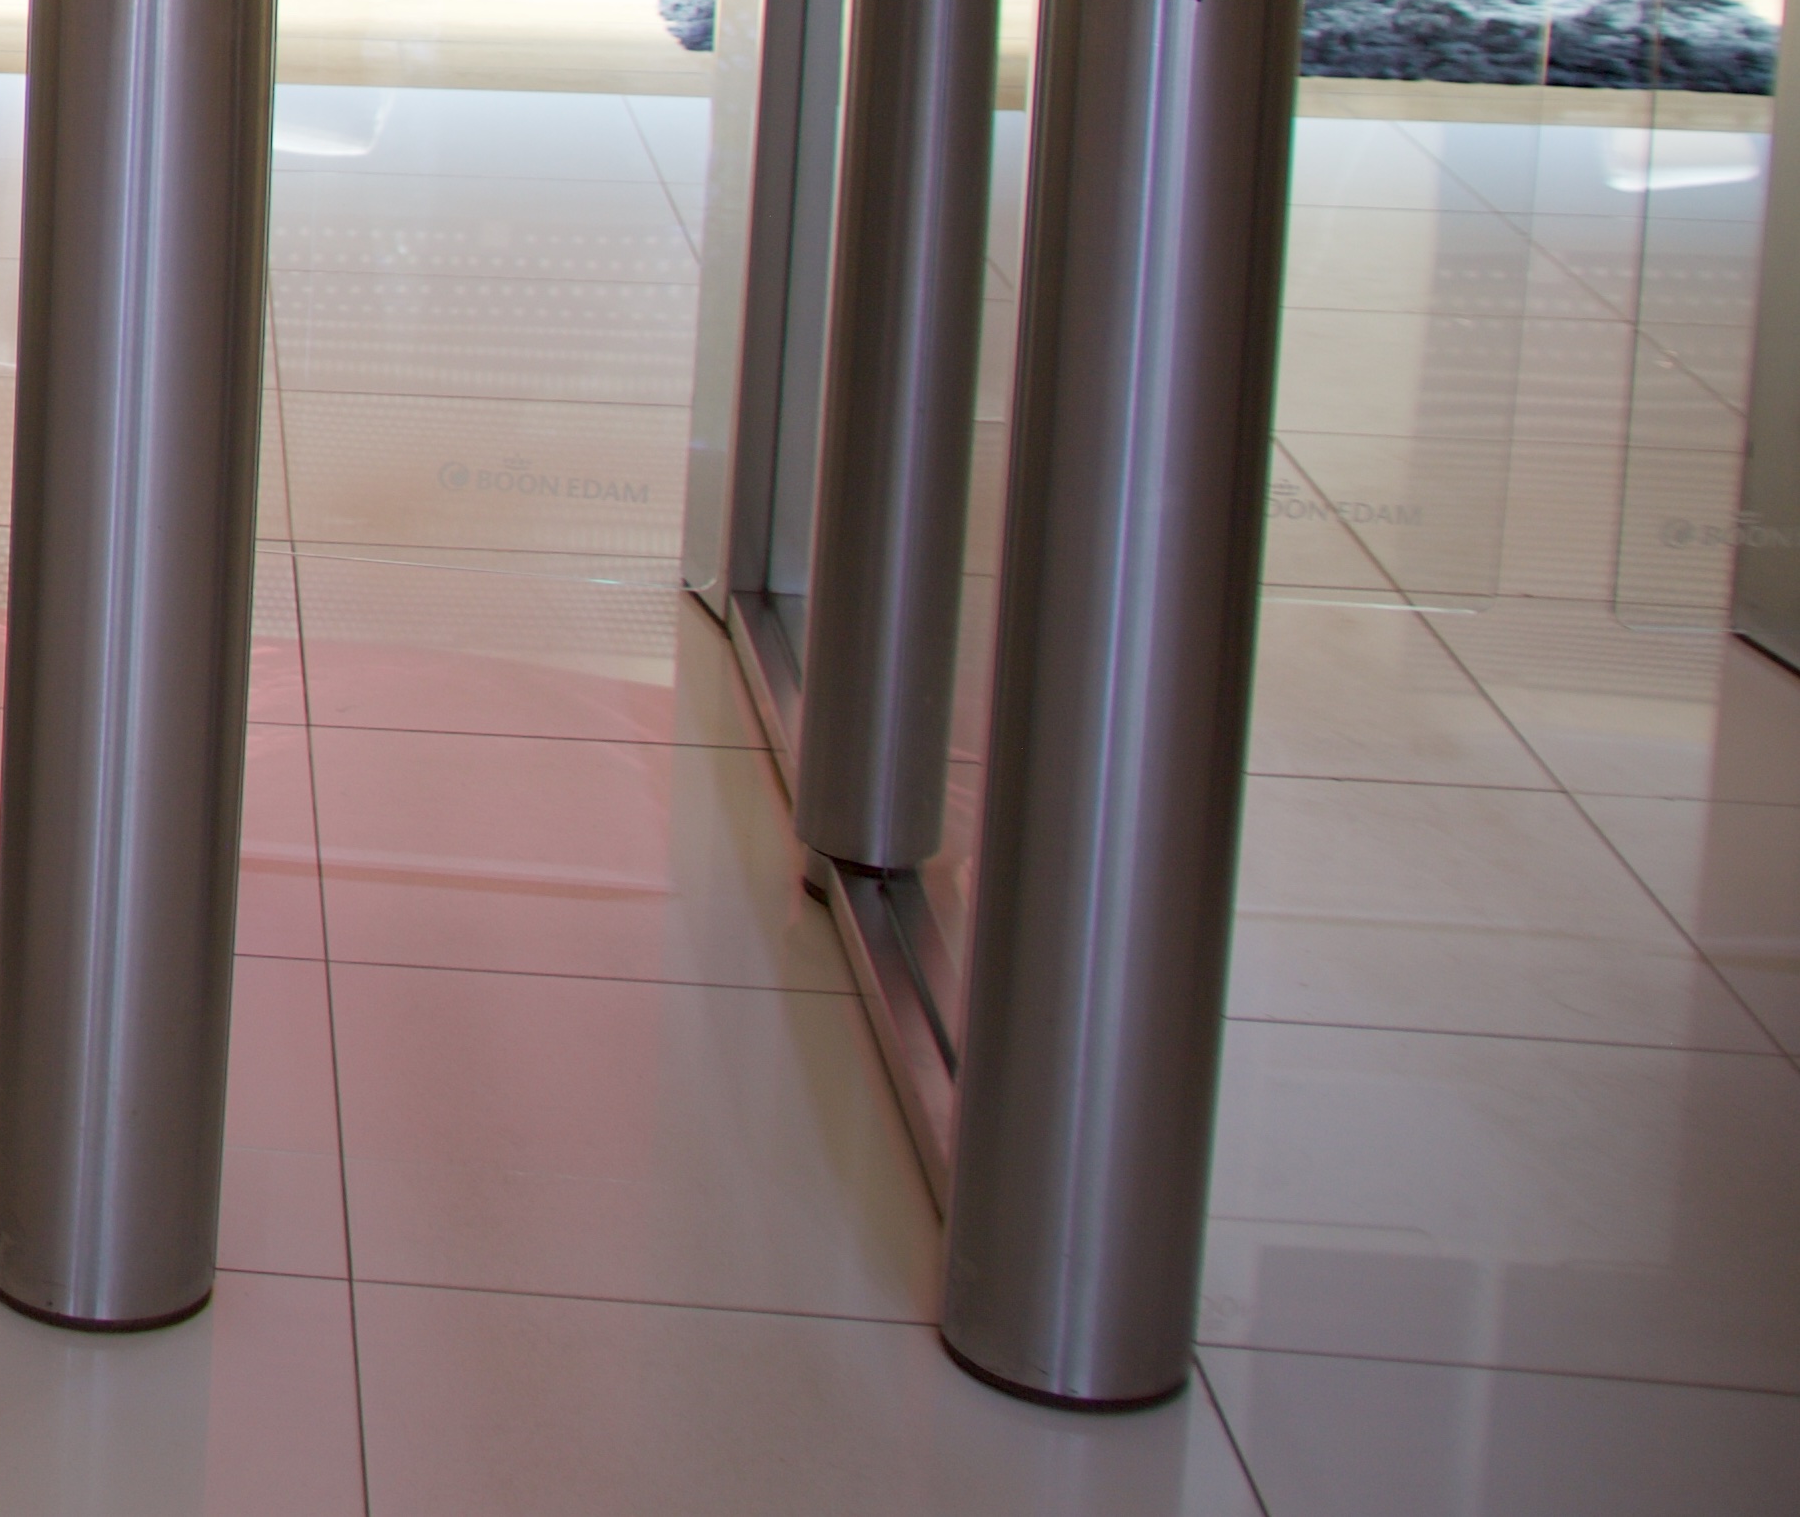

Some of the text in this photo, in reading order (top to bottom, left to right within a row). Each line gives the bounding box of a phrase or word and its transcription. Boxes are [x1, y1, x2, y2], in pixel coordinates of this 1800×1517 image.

[476, 469, 650, 504] BOON EDAM
[1263, 496, 1423, 526] OON EDAM
